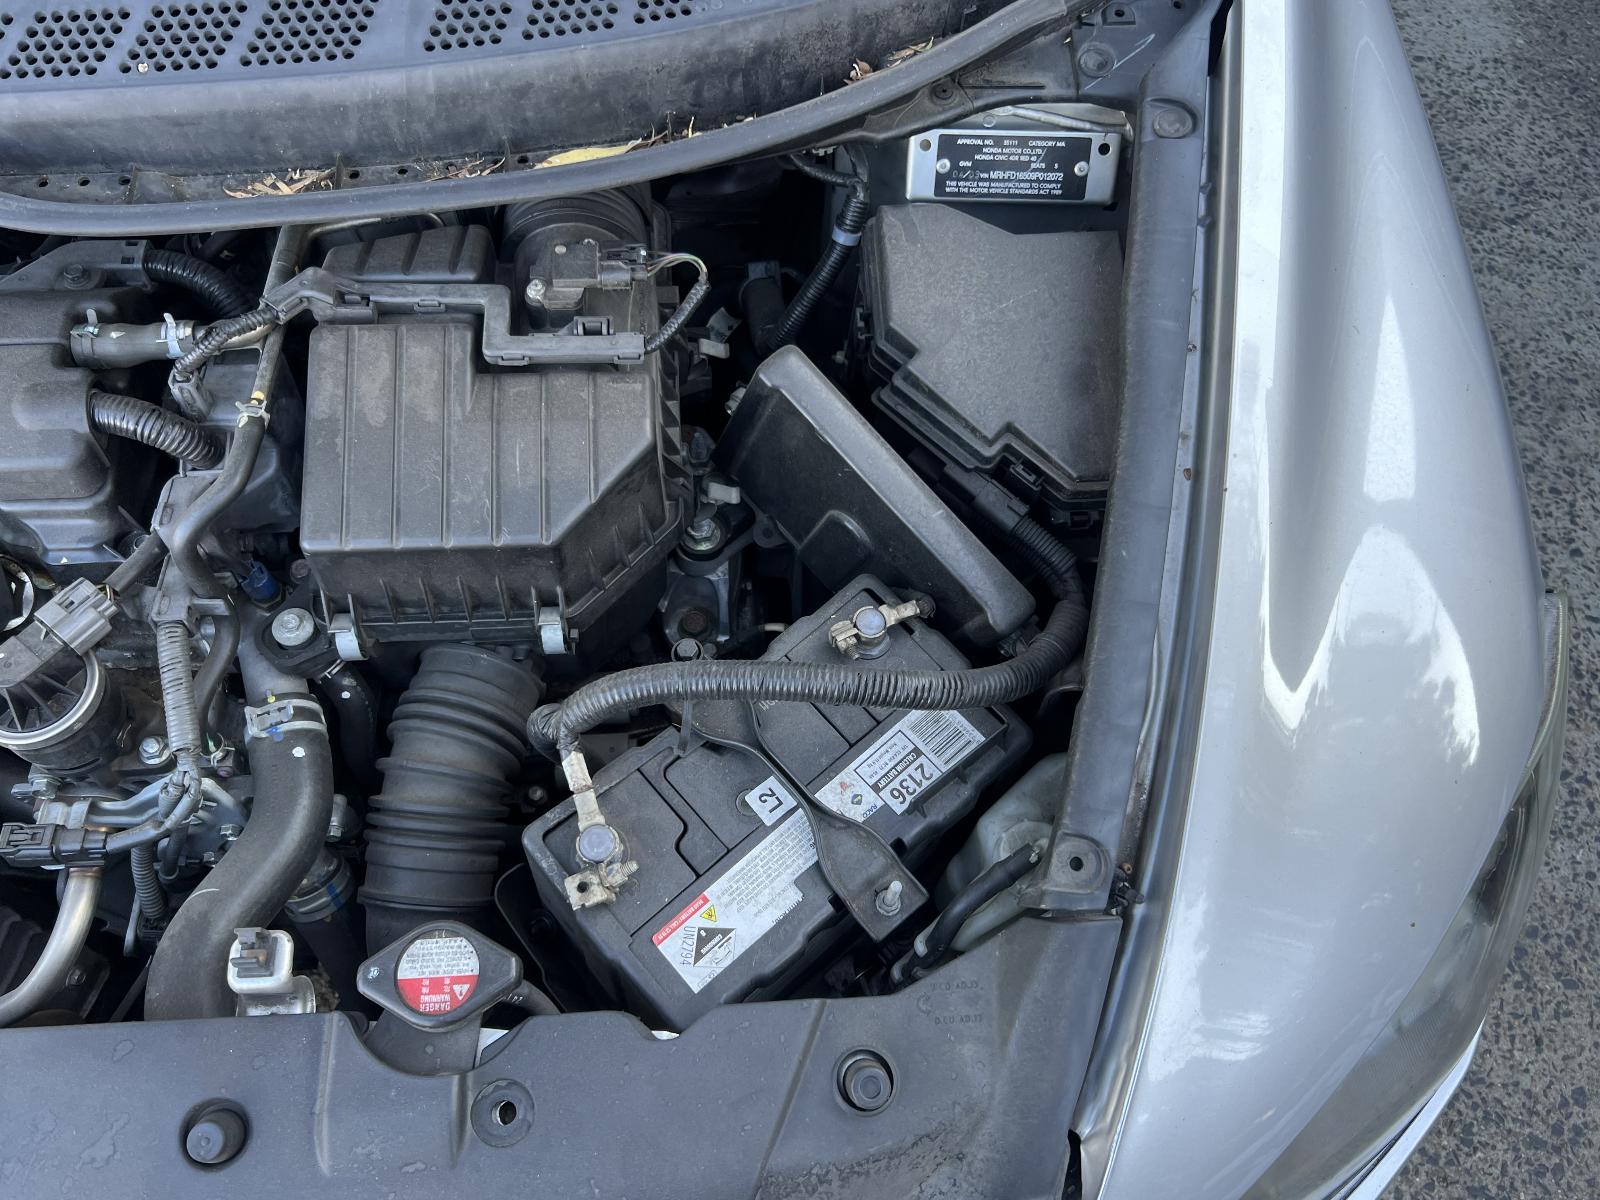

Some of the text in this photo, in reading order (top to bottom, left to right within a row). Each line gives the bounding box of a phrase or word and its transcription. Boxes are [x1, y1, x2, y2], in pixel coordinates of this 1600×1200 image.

[896, 752, 917, 774] CALCIUM
[877, 769, 898, 789] BATTERY
[890, 762, 934, 804] 2136
[758, 787, 784, 814] L2
[680, 926, 697, 965] UN2794
[420, 1002, 450, 1012] DANGER
